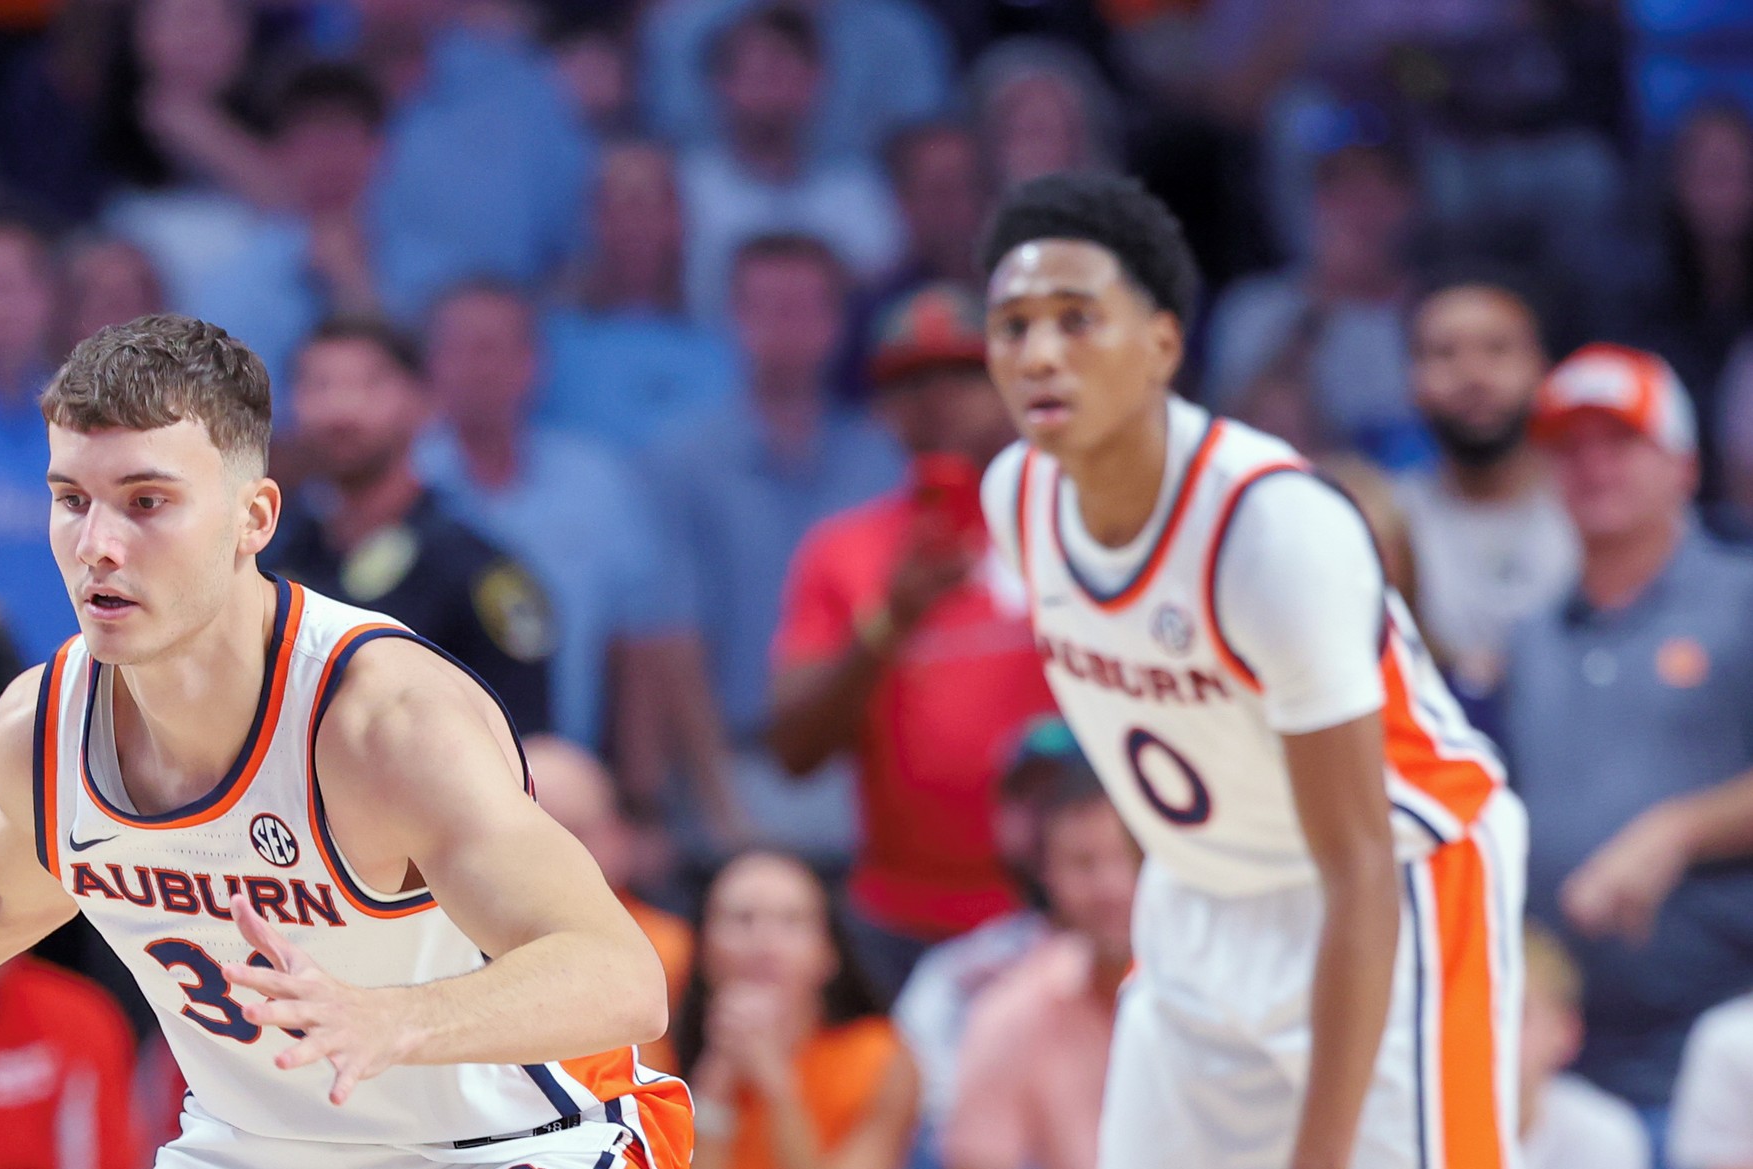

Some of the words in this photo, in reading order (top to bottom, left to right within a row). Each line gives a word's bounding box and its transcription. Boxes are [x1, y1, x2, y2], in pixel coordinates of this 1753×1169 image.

[1124, 726, 1211, 827] 0
[250, 813, 300, 868] SEC
[70, 862, 347, 927] AUBURN
